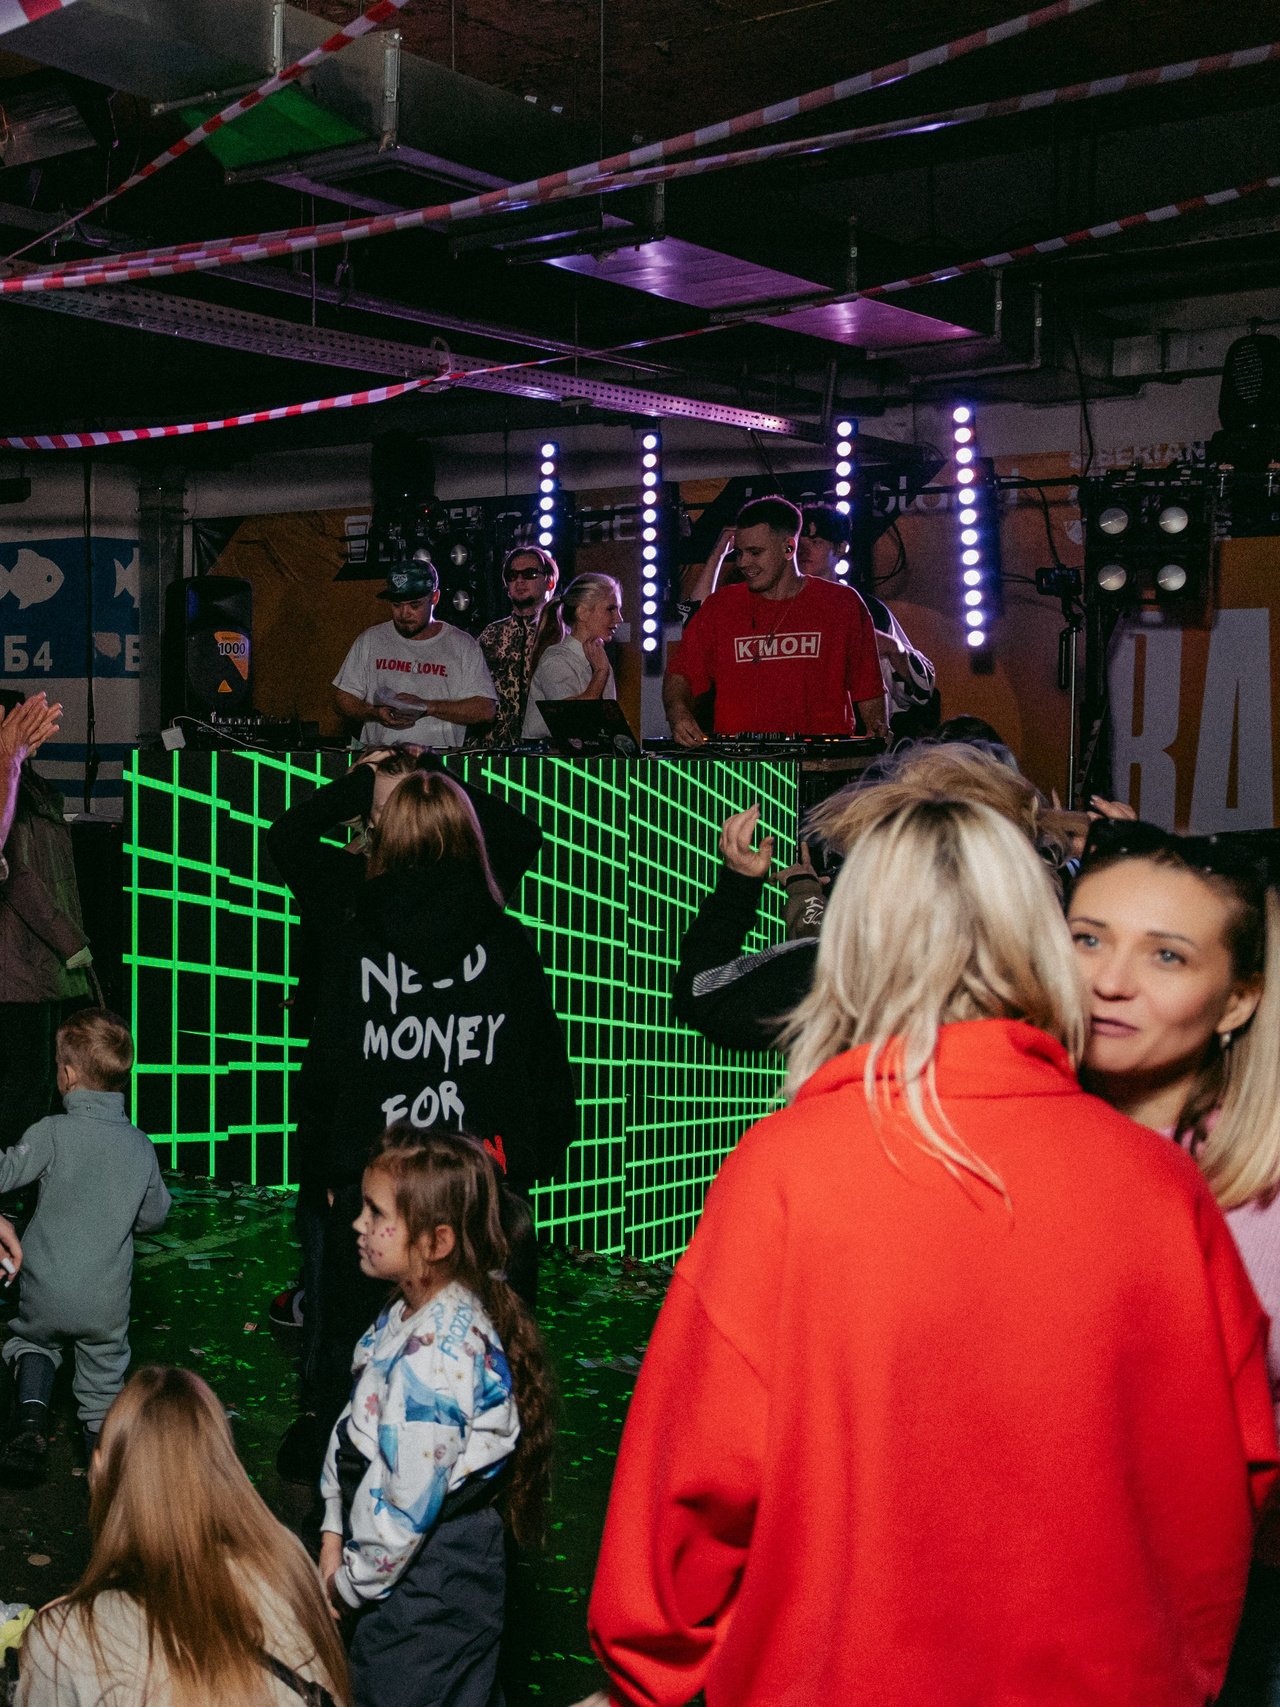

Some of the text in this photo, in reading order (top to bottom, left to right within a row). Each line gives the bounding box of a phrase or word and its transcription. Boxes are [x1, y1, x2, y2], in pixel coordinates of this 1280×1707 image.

[4, 635, 53, 672] Б4
[218, 642, 246, 656] 1000
[376, 659, 448, 677] VLONE LOVE.
[360, 943, 487, 1015] NED
[363, 1013, 506, 1073] MONEY
[381, 1080, 465, 1131] FOR
